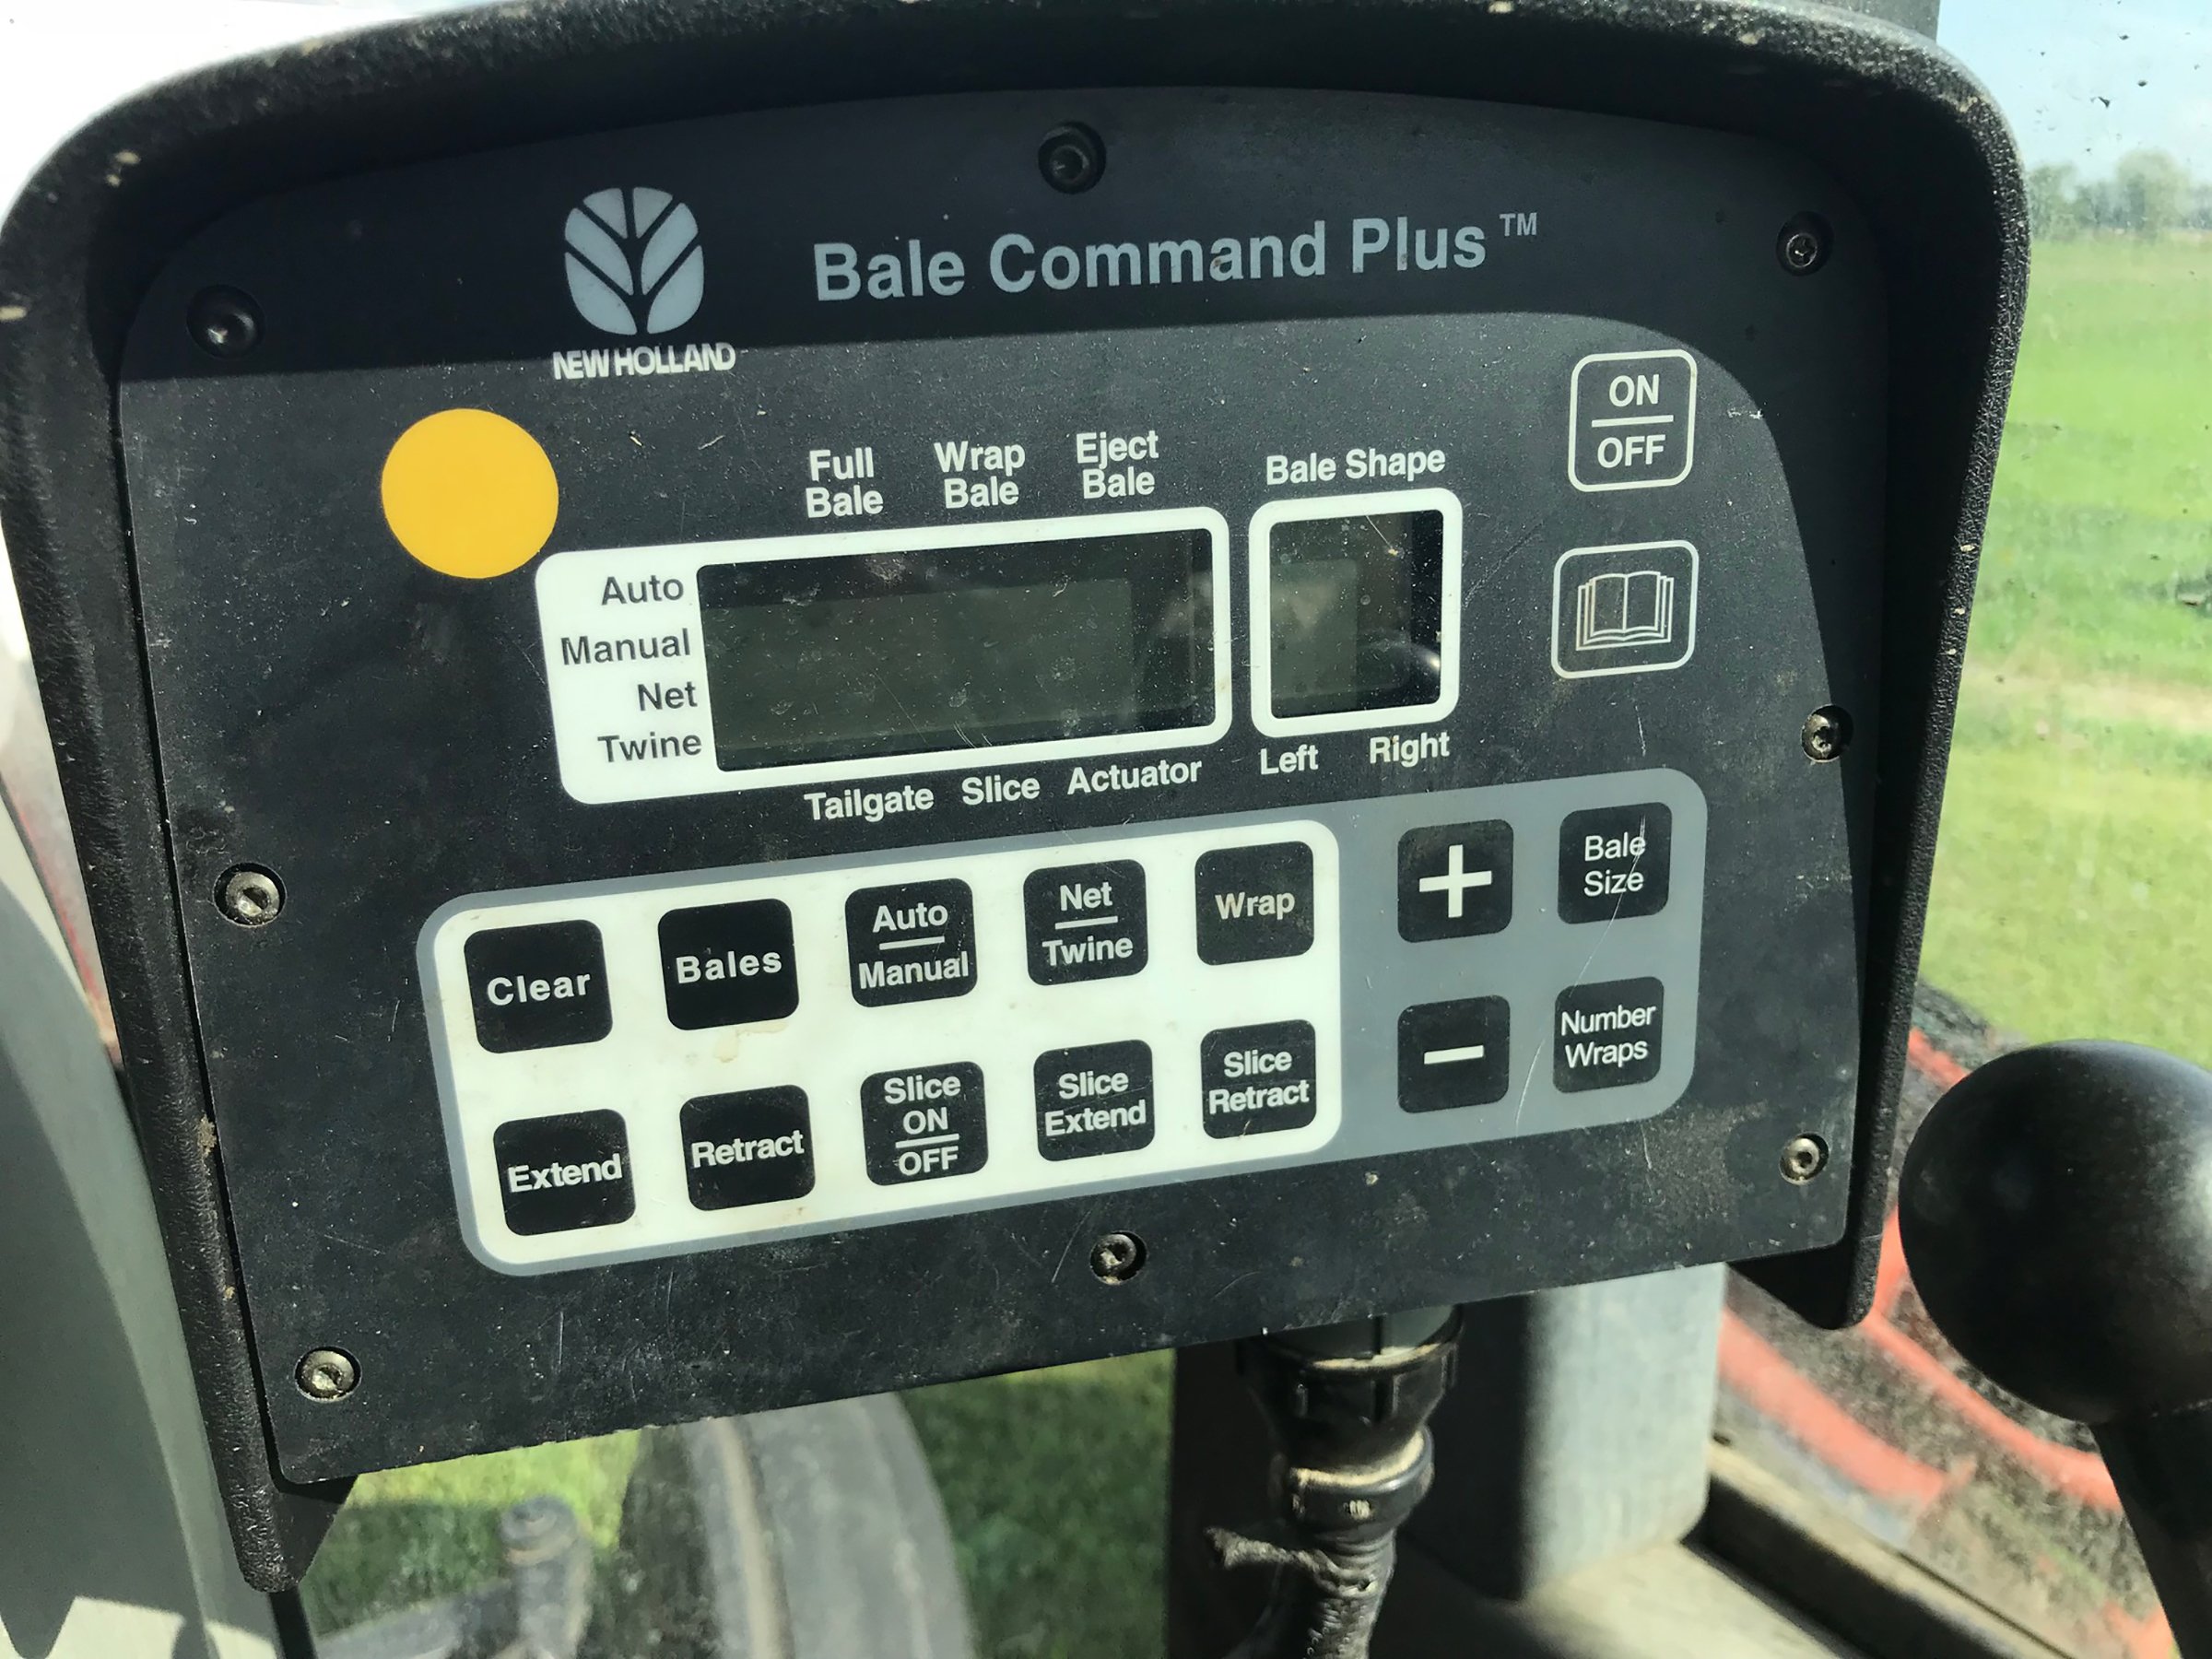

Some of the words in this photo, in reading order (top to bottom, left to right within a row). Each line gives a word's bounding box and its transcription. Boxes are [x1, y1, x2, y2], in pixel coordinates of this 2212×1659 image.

[814, 241, 965, 301] Bale
[989, 220, 1326, 294] Command
[1352, 218, 1486, 273] Plus
[553, 348, 610, 380] NEW
[614, 342, 736, 376] HOLLAND
[1608, 375, 1660, 406] ON
[935, 441, 1025, 476] Wrap
[1076, 430, 1159, 466] Eject
[1597, 436, 1665, 469] OFF
[809, 448, 874, 481] Full
[1265, 454, 1335, 484] Bale
[1346, 447, 1445, 483] Shape
[944, 477, 1019, 509] Bale
[1082, 467, 1155, 499] Bale
[806, 486, 883, 518] Bale
[601, 575, 684, 606] Auto
[561, 629, 690, 665] Manual
[638, 682, 697, 710] Net
[597, 728, 702, 762] Twine
[1260, 744, 1318, 776] Left
[1370, 732, 1450, 767] Right
[961, 775, 1040, 806] Slice
[1067, 759, 1202, 796] Actuator
[804, 784, 935, 822] Tailgate
[1583, 833, 1646, 862] Bale
[1060, 883, 1112, 910] Net
[1583, 869, 1644, 895] Size
[872, 902, 947, 933] Auto
[1215, 890, 1295, 921] Wrap
[676, 949, 782, 984] Bales
[1042, 936, 1133, 966] Twine
[859, 953, 969, 989] Manual
[487, 970, 591, 1006] Clear
[1560, 1004, 1656, 1033] Number
[1224, 1050, 1292, 1077] Slice
[1564, 1039, 1648, 1068] Wraps
[884, 1075, 960, 1103] Slice
[1058, 1071, 1128, 1097] Slice
[1209, 1080, 1310, 1115] Retract
[902, 1108, 948, 1133] ON
[1045, 1101, 1146, 1136] Extend
[691, 1130, 804, 1169] Retract
[898, 1146, 959, 1176] OFF
[508, 1154, 622, 1194] Extend
